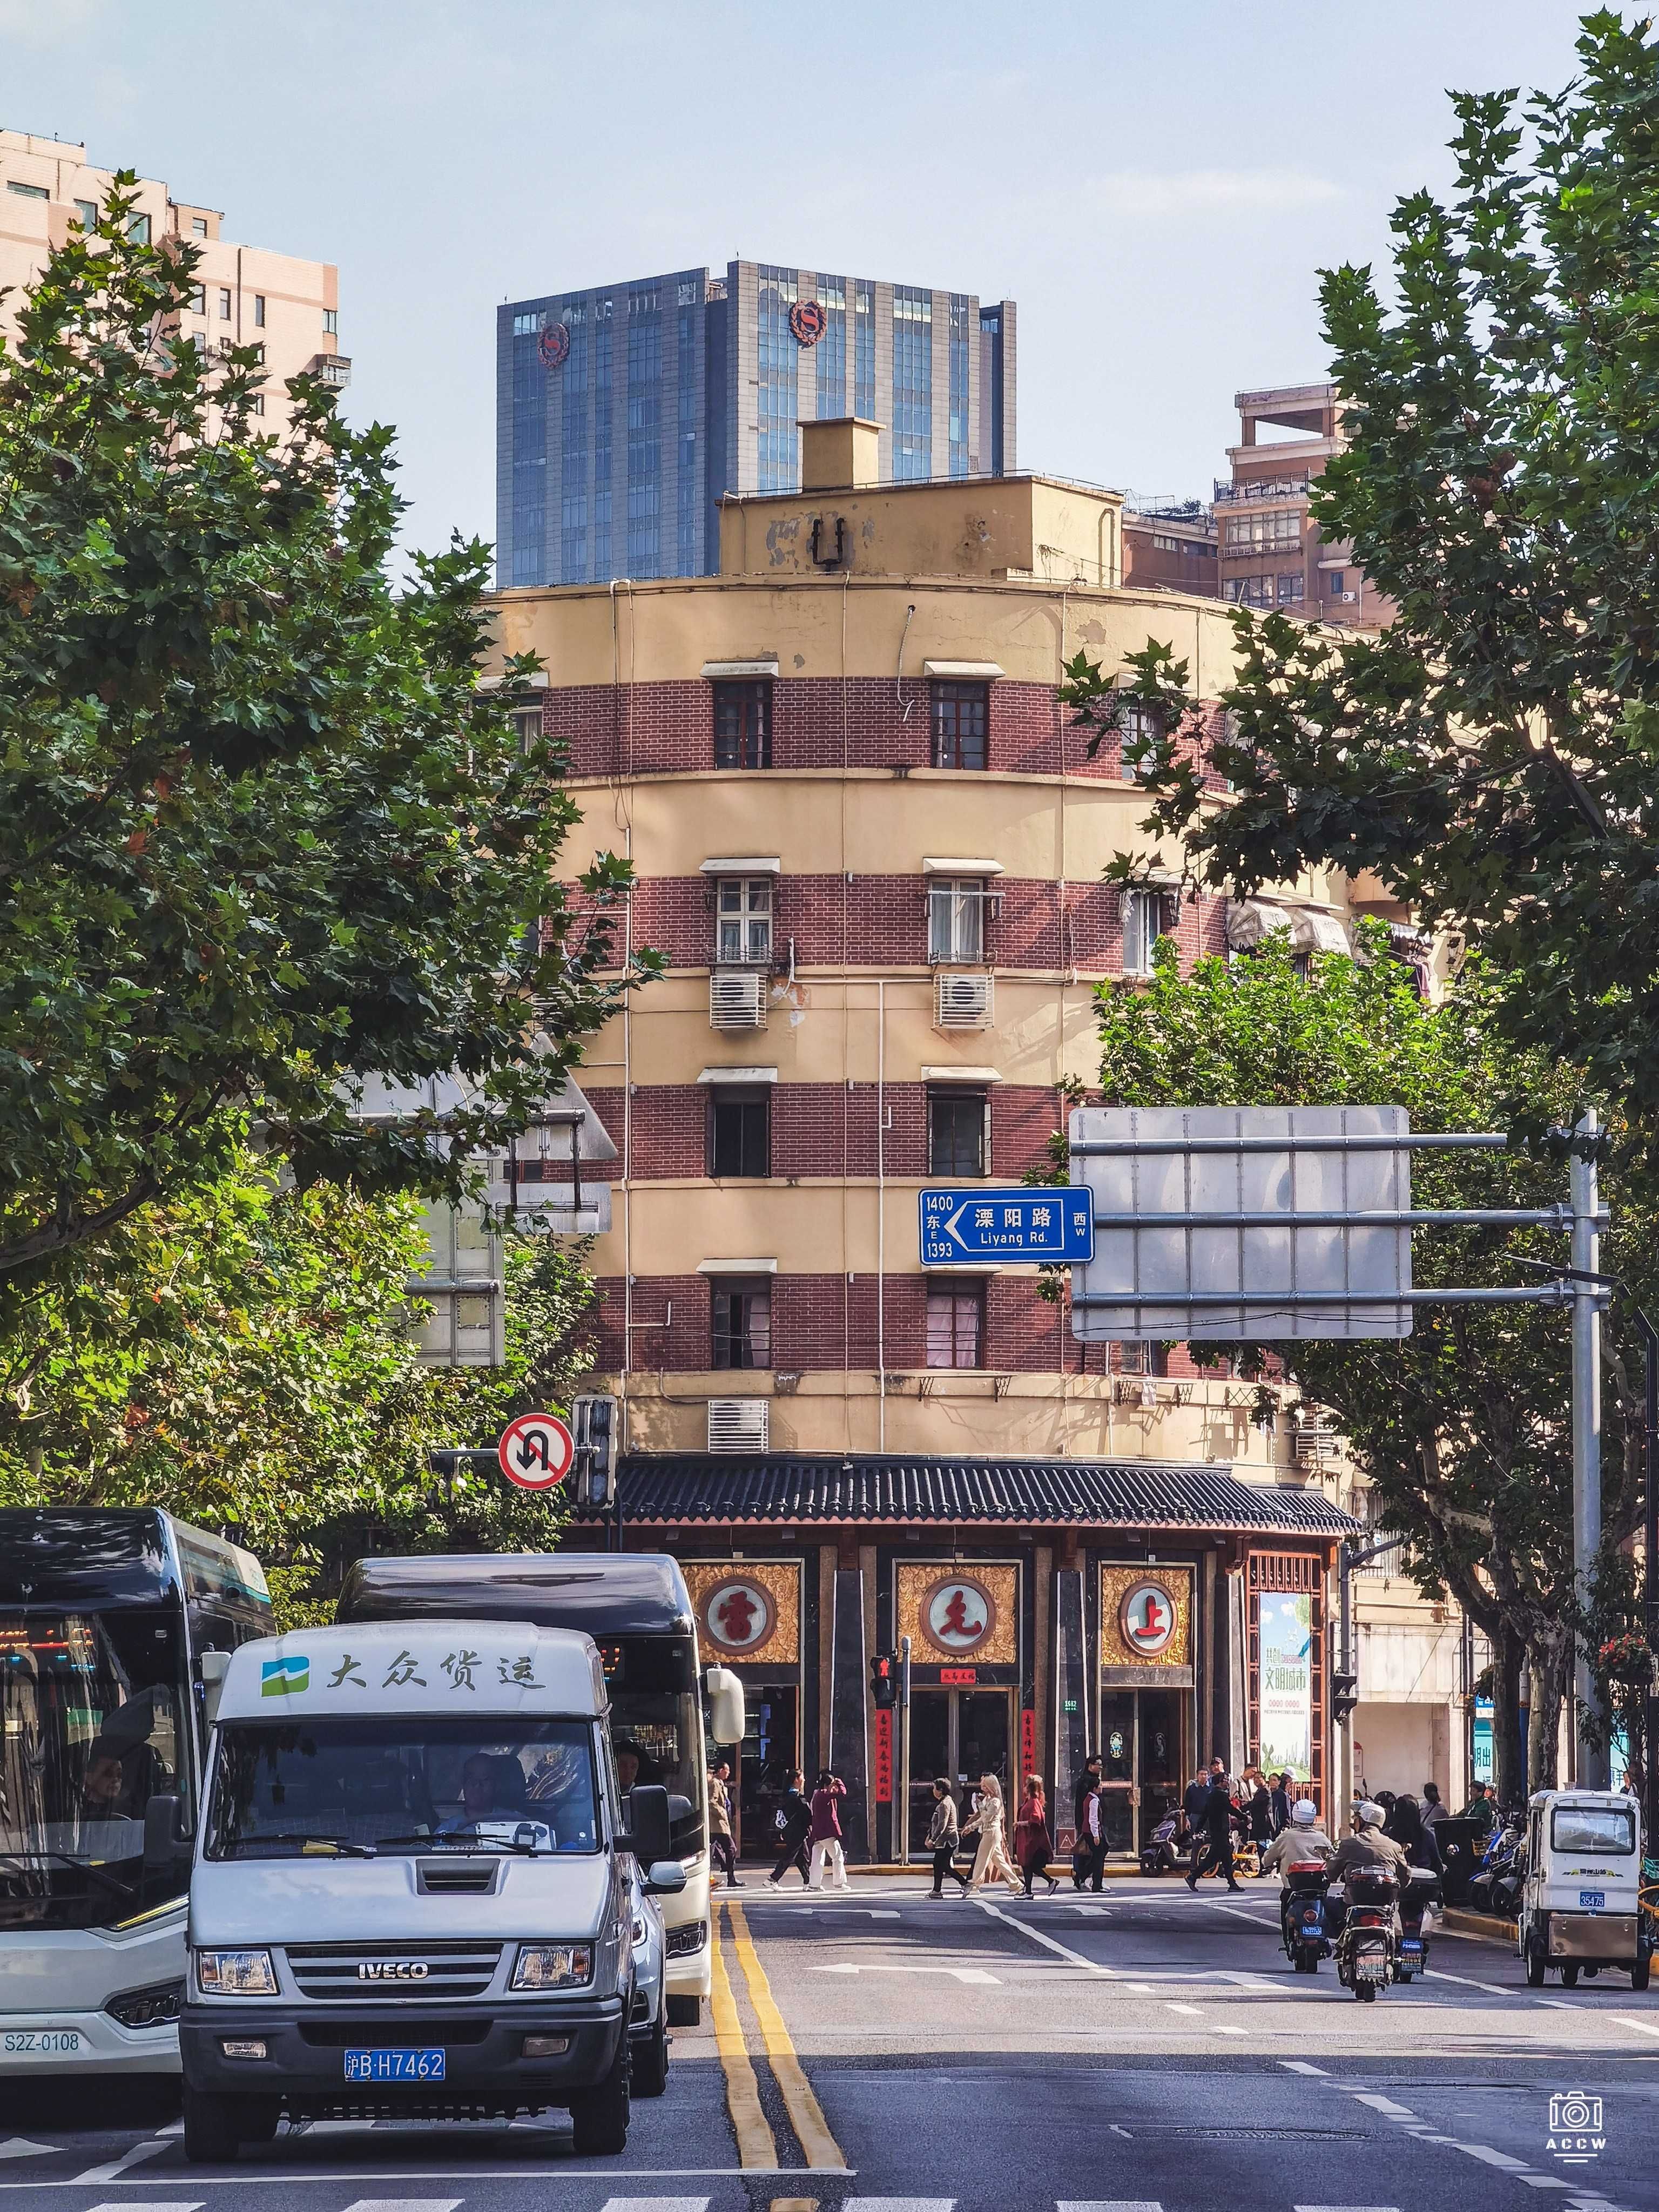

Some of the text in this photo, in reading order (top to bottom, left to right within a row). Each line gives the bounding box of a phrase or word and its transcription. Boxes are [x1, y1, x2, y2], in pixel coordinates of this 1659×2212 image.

[926, 1196, 953, 1211] 1400
[926, 1215, 940, 1230] 东
[975, 1207, 1052, 1228] 溧阳路
[1073, 1212, 1087, 1226] 西
[981, 1231, 1048, 1246] Liyang Rd.
[927, 1243, 952, 1258] 1393
[1135, 1595, 1166, 1636] 上
[1266, 1647, 1280, 1665] 共创
[327, 1650, 546, 1691] 大众货运
[1265, 1667, 1306, 1691] 文明城市
[1581, 1896, 1603, 1906] 35475
[359, 1963, 429, 1979] IVECO
[5, 2033, 79, 2051] S2Z-0108
[347, 2054, 442, 2076] 沪B·H7462
